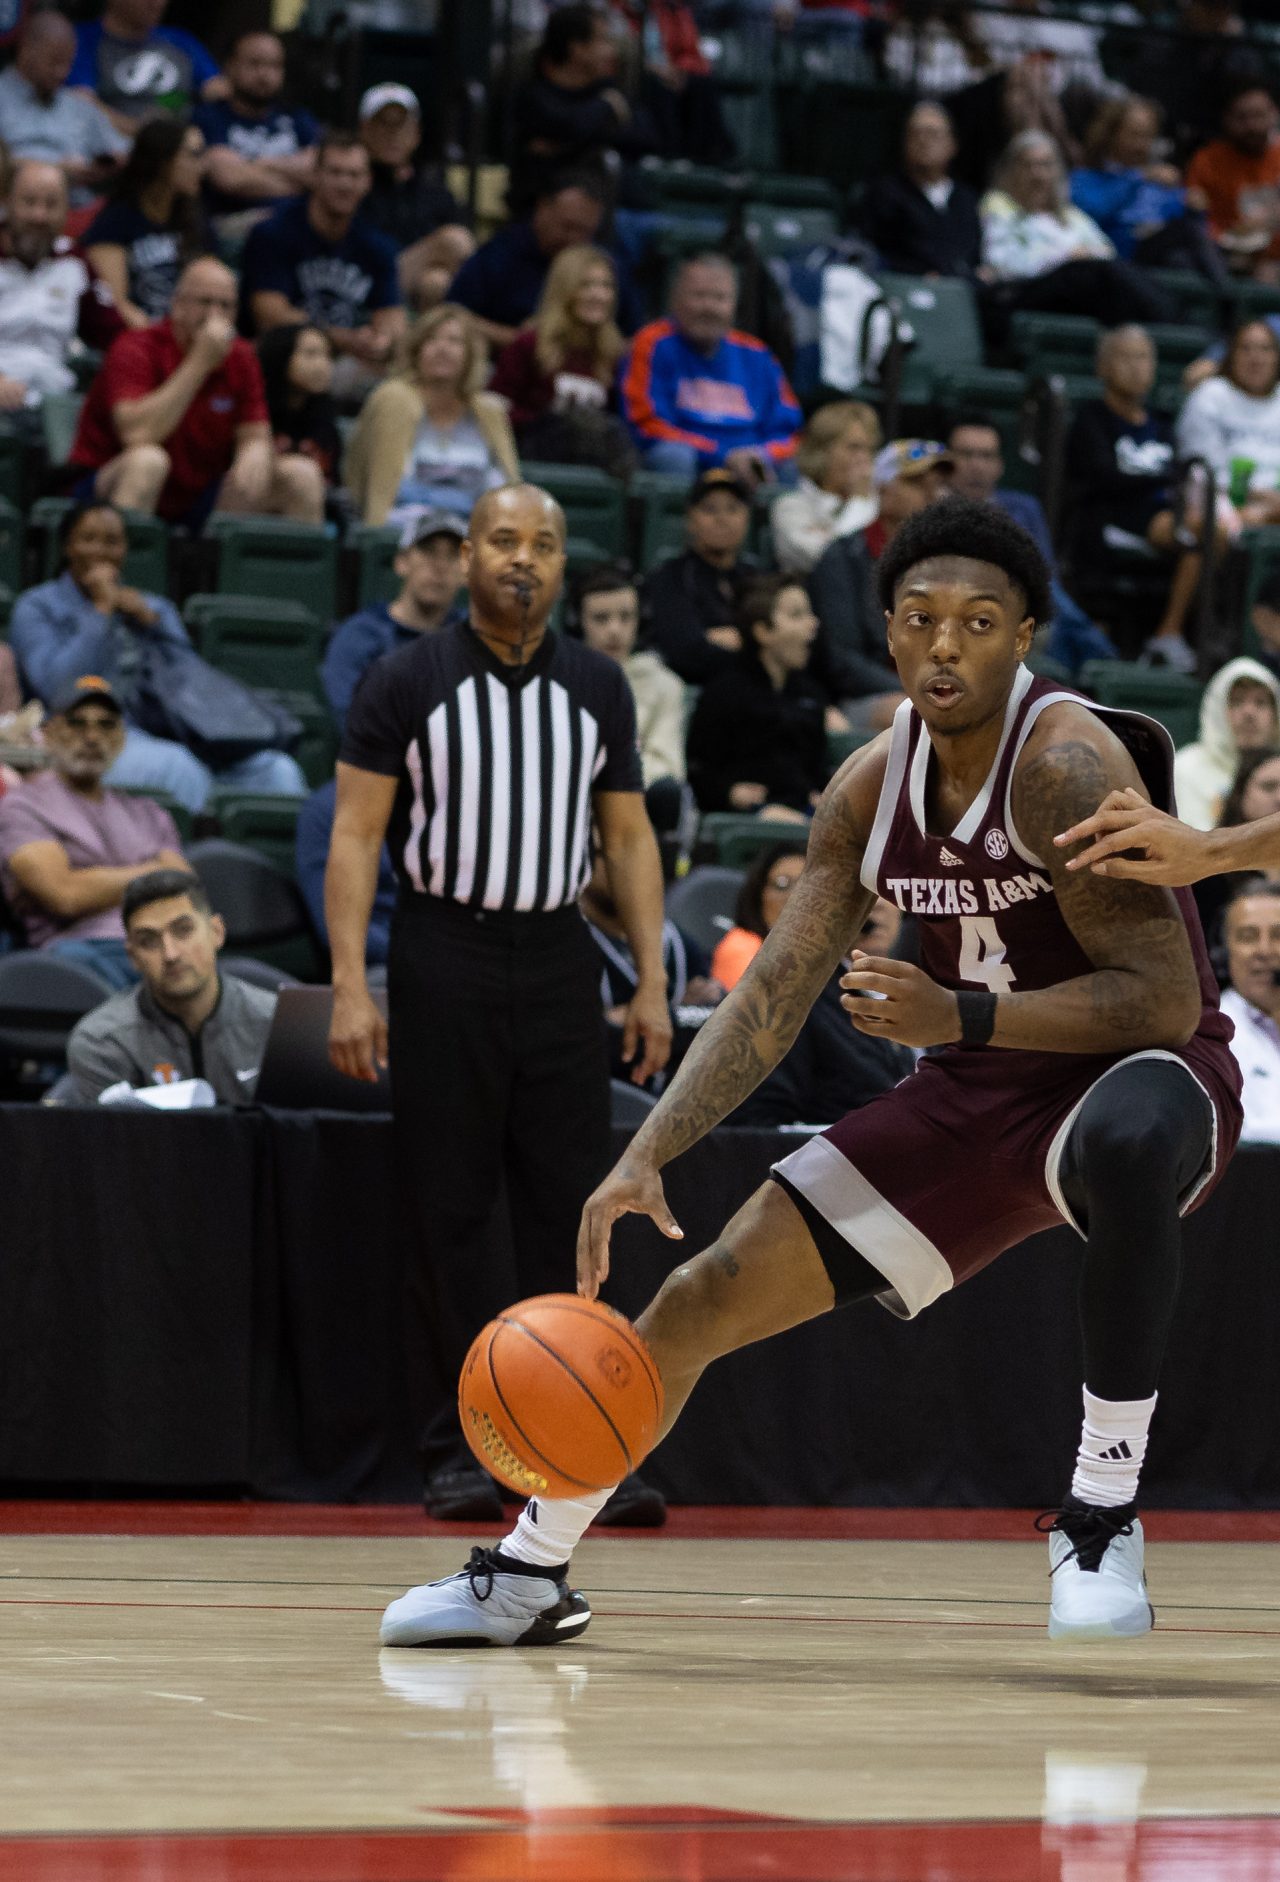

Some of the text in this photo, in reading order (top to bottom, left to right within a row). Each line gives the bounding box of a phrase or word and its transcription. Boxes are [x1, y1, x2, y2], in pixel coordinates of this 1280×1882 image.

[986, 831, 1008, 858] SEC
[886, 878, 979, 915] TEXAS
[983, 871, 1054, 912] A&M
[958, 916, 1017, 993] 4
